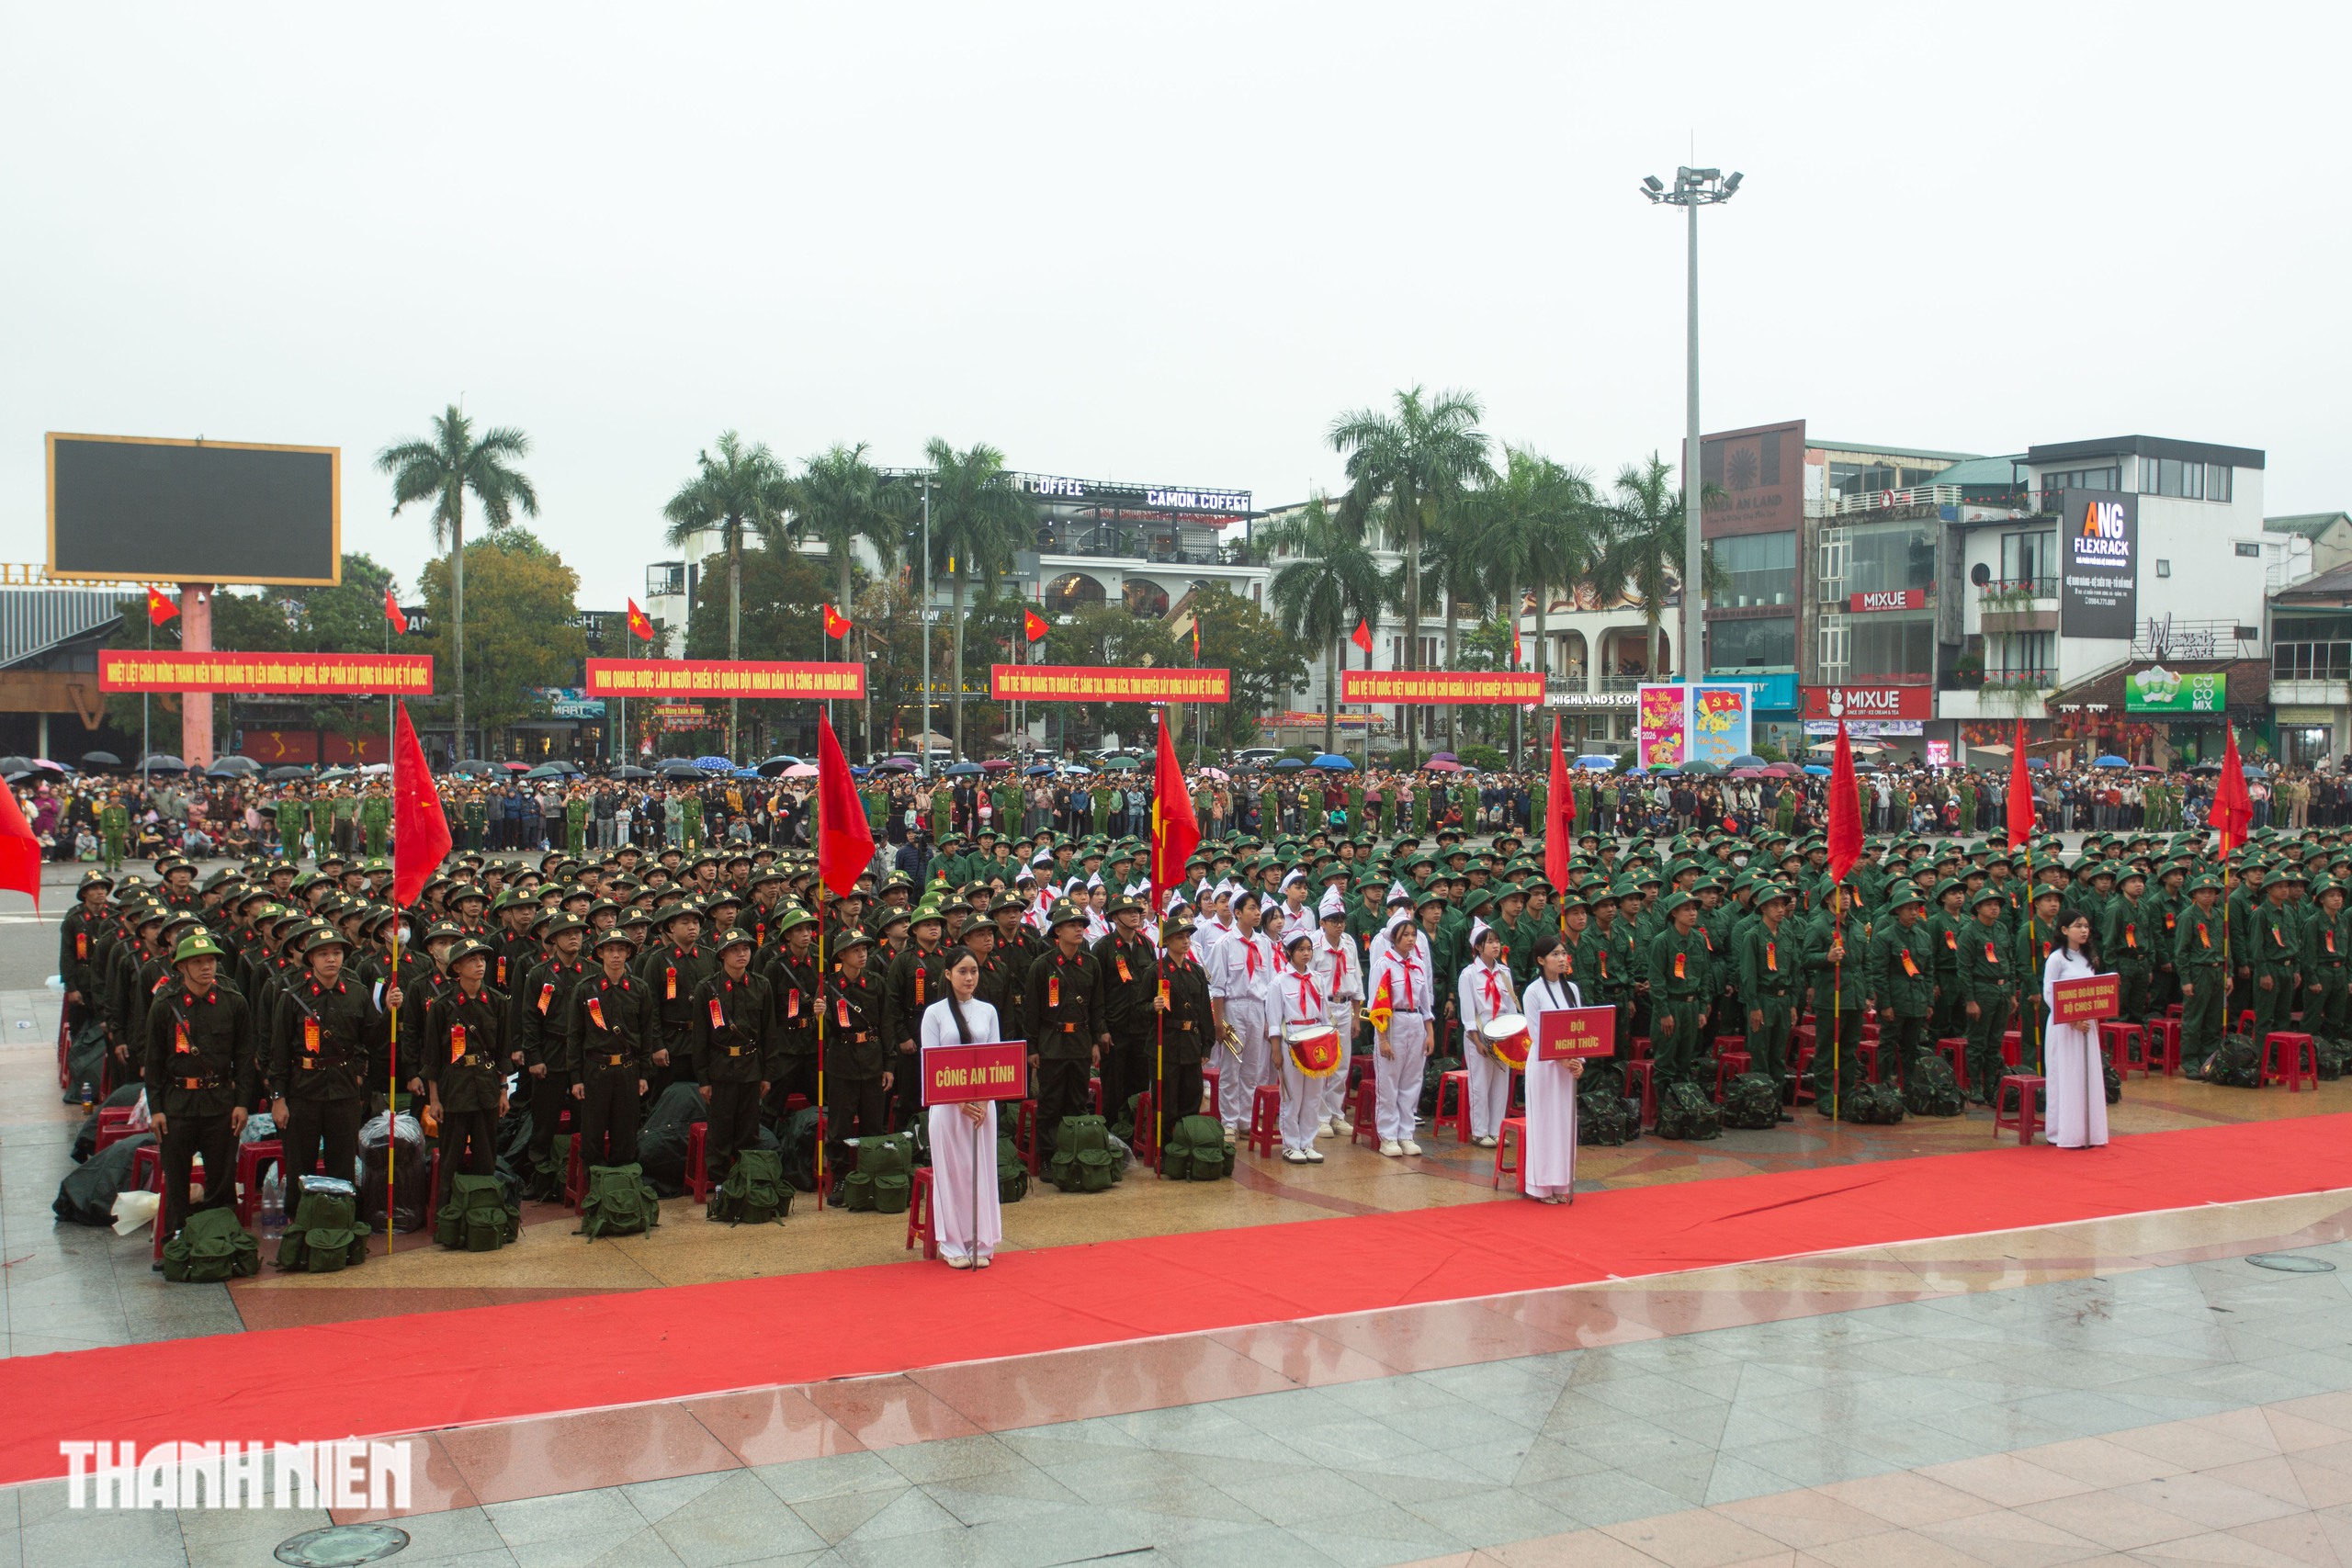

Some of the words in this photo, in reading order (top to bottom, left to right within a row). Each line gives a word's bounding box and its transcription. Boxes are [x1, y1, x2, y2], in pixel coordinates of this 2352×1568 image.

[1030, 478, 1083, 496] COFFEE
[1147, 491, 1195, 508] CAMON
[2083, 501, 2124, 539] ANG
[2074, 537, 2129, 556] FLEXRACK
[1864, 591, 1906, 607] MIXUE
[2147, 611, 2215, 655] Moments
[2182, 647, 2214, 658] CAFE
[107, 659, 125, 687] NHIỆT
[126, 659, 138, 687] LIỆT
[140, 659, 155, 682] CHÀO
[156, 660, 175, 682] MỪNG
[175, 664, 194, 683] THANH
[195, 660, 209, 683] NIÊN
[210, 658, 224, 683] TỈNH
[225, 659, 244, 686] QUẢNG
[245, 665, 254, 688] TRỊ
[255, 661, 266, 683] LÊN
[267, 661, 287, 684] ĐƯỜNG
[288, 662, 303, 688] NHẬP
[319, 662, 330, 684] GÓP
[330, 660, 346, 685] PHẦN
[347, 662, 358, 685] XÂY
[359, 665, 374, 689] DỰNG
[375, 663, 382, 685] VÀ
[383, 661, 394, 685] BẢO
[395, 663, 402, 689] VỆ
[403, 660, 410, 685] TỔ
[411, 661, 427, 688] QUỐC!
[595, 670, 611, 688] VINH
[613, 671, 635, 690] QUANG
[636, 670, 654, 692] ĐƯỢC
[656, 667, 670, 688] LÀM
[671, 668, 691, 688] NGƯỜI
[692, 666, 712, 689] CHIẾN
[713, 669, 721, 689] SĨ
[721, 669, 739, 691] QUÂN
[740, 669, 751, 693] ĐỘI
[752, 669, 770, 690] NHÂN
[771, 670, 785, 690] DÂN
[786, 670, 794, 690] VÀ
[796, 670, 813, 690] CÔNG
[814, 674, 823, 690] AN
[824, 671, 842, 690] NHÂN
[842, 671, 858, 691] DÂN!
[999, 670, 1010, 692] TUỔI
[1010, 671, 1019, 692] TRẺ
[1020, 671, 1031, 692] TỈNH
[1032, 671, 1048, 694] QUẢNG
[1056, 674, 1070, 693] ĐOÀN
[1080, 674, 1093, 694] SÁNG
[1104, 678, 1117, 694] XUNG
[1130, 676, 1141, 694] TÌNH
[1141, 676, 1159, 698] NGUYỆN
[1160, 676, 1169, 694] XÂY
[1170, 678, 1182, 698] DỰNG
[1183, 676, 1188, 694] VÀ
[1189, 674, 1198, 694] BẢO
[1199, 676, 1204, 698] VỆ
[1205, 673, 1211, 694] TỔ
[1212, 674, 1225, 697] QUỐC!
[1348, 676, 1359, 696] BẢO
[1361, 680, 1368, 699] VỆ
[1369, 675, 1376, 696] TỔ
[1377, 676, 1391, 698] QUỐC
[1392, 680, 1404, 699] VIỆT
[1405, 681, 1418, 696] NAM
[1419, 680, 1426, 696] XÃ
[1427, 679, 1436, 699] HỘI
[1437, 677, 1448, 697] CHỦ
[1449, 679, 1465, 697] NGHĨA
[1466, 679, 1473, 697] LÀ
[1474, 681, 1482, 699] SỰ
[1482, 680, 1501, 699] NGHIỆP
[1502, 677, 1513, 697] CỦA
[1513, 679, 1528, 697] TOÀN
[1528, 679, 1540, 697] DÂN!
[1552, 695, 1616, 705] HIGHLANDS
[1617, 695, 1638, 705] COF
[1642, 691, 1655, 702] Chúc
[1655, 691, 1671, 706] Mừng
[1847, 691, 1900, 708] MIXUE
[2193, 688, 2214, 700] CO
[552, 705, 584, 715] MART
[2192, 700, 2213, 710] MIX
[2057, 989, 2077, 1001] TRUNG
[2078, 986, 2094, 998] ĐOÀN
[2064, 1002, 2073, 1015] BỘ
[2074, 1001, 2092, 1012] CHQS
[2094, 997, 2109, 1009] TỈNH
[1570, 1019, 1585, 1034] ĐỘI
[1555, 1039, 1575, 1050] NGHI
[1577, 1035, 1599, 1048] THỨC
[936, 1066, 967, 1088] CÔNG
[970, 1067, 986, 1084] AN
[989, 1060, 1014, 1083] TỈNH
